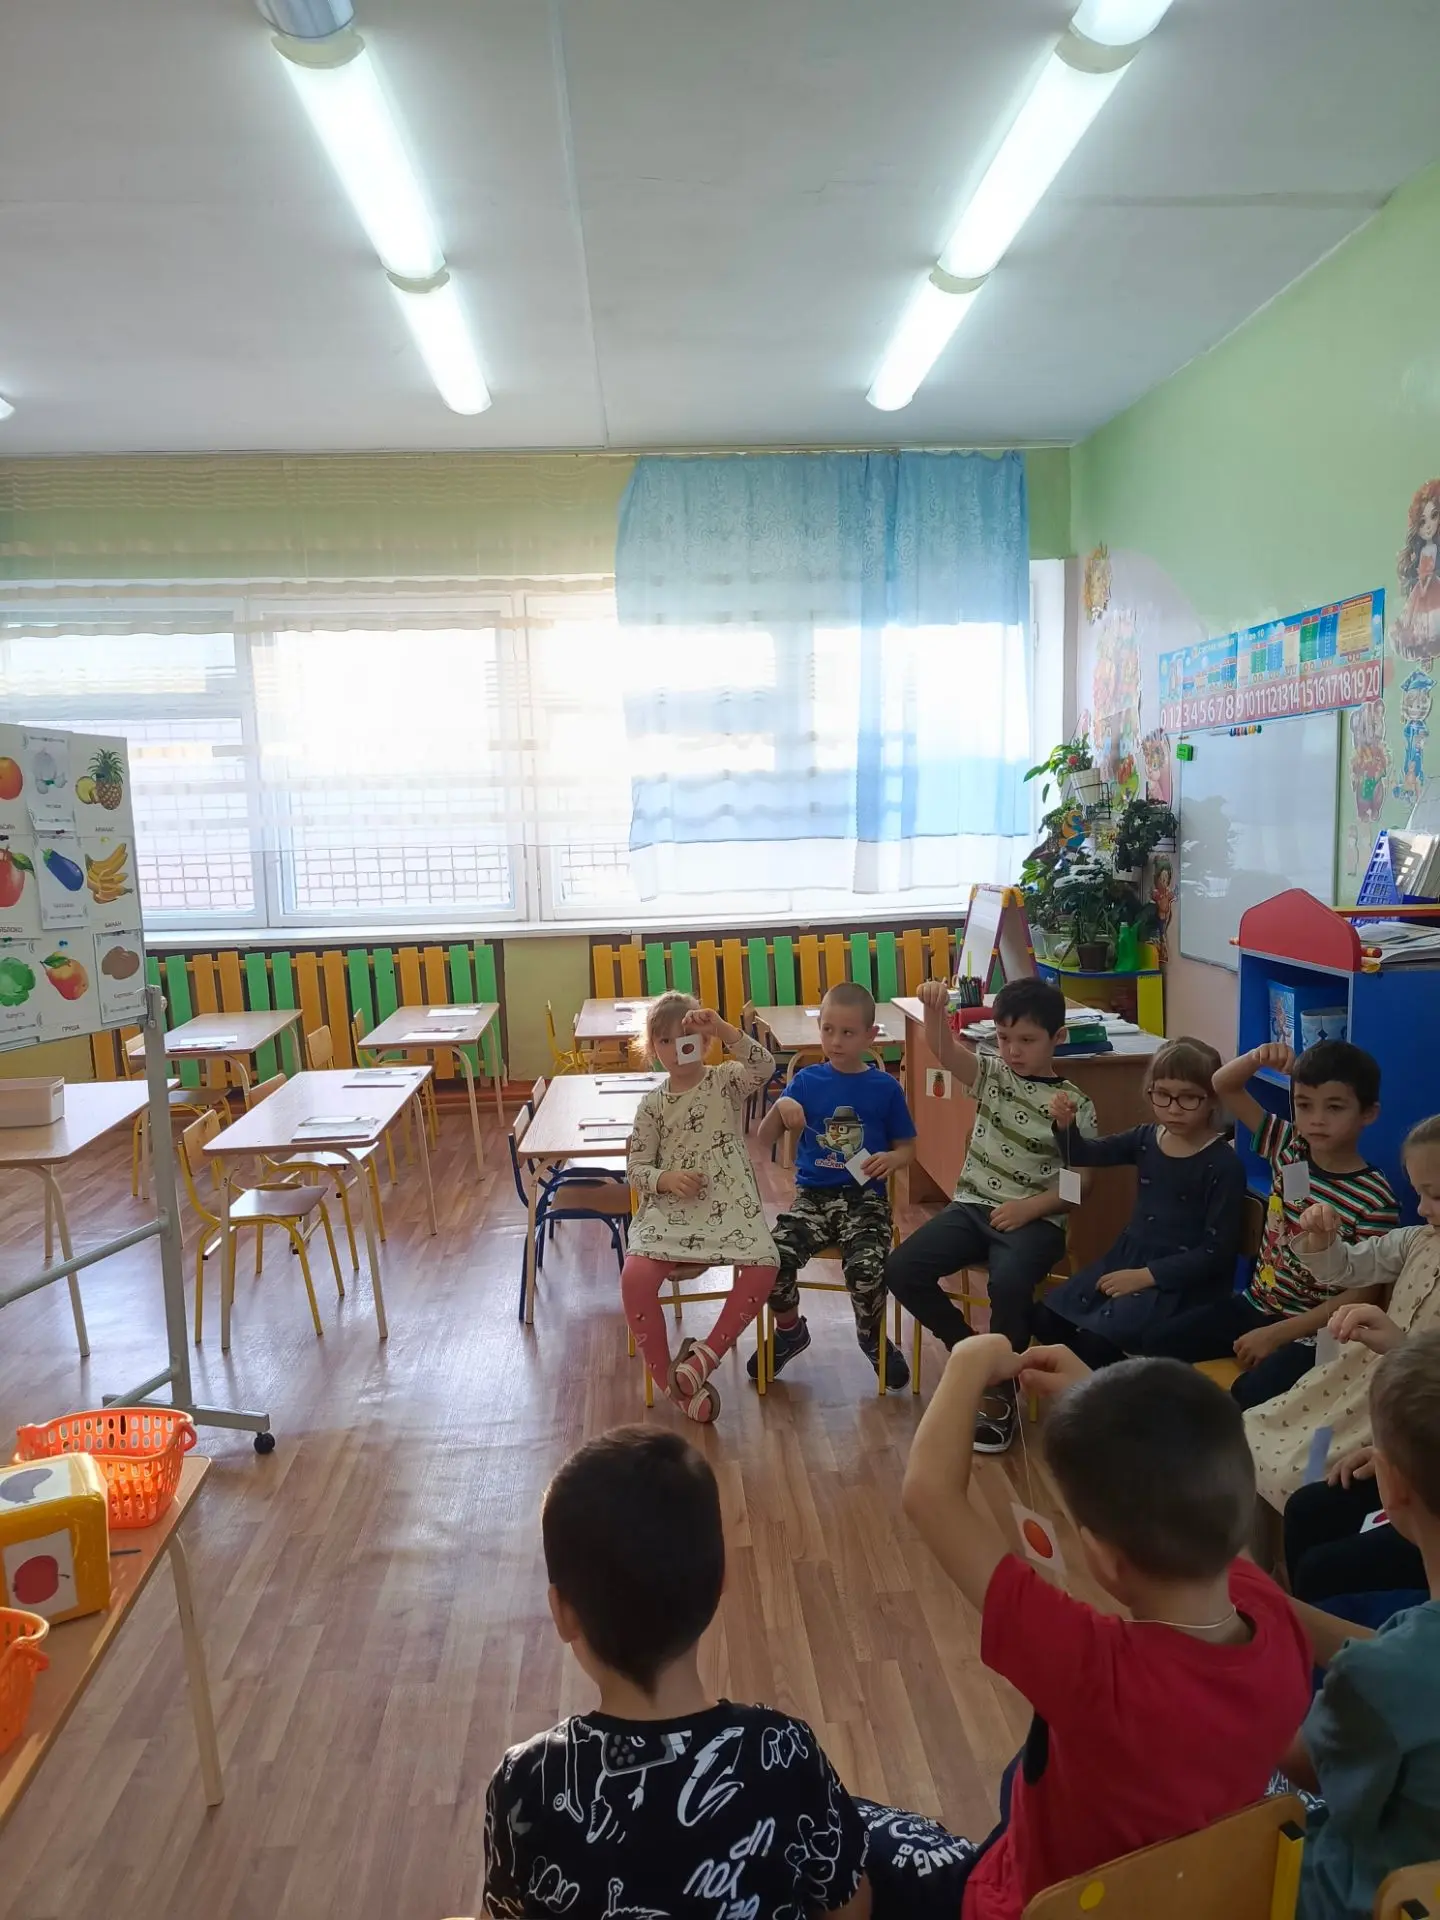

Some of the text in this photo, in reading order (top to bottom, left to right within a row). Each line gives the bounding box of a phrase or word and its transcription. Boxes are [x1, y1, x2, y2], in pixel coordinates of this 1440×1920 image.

[1257, 627, 1265, 638] 10
[1161, 665, 1380, 728] 0 1 2 3 4 5 6 7 8 9 10 11 12 13 14 15 16 17 18 19 20
[729, 1816, 775, 1860] UP
[683, 1859, 746, 1900] YOU
